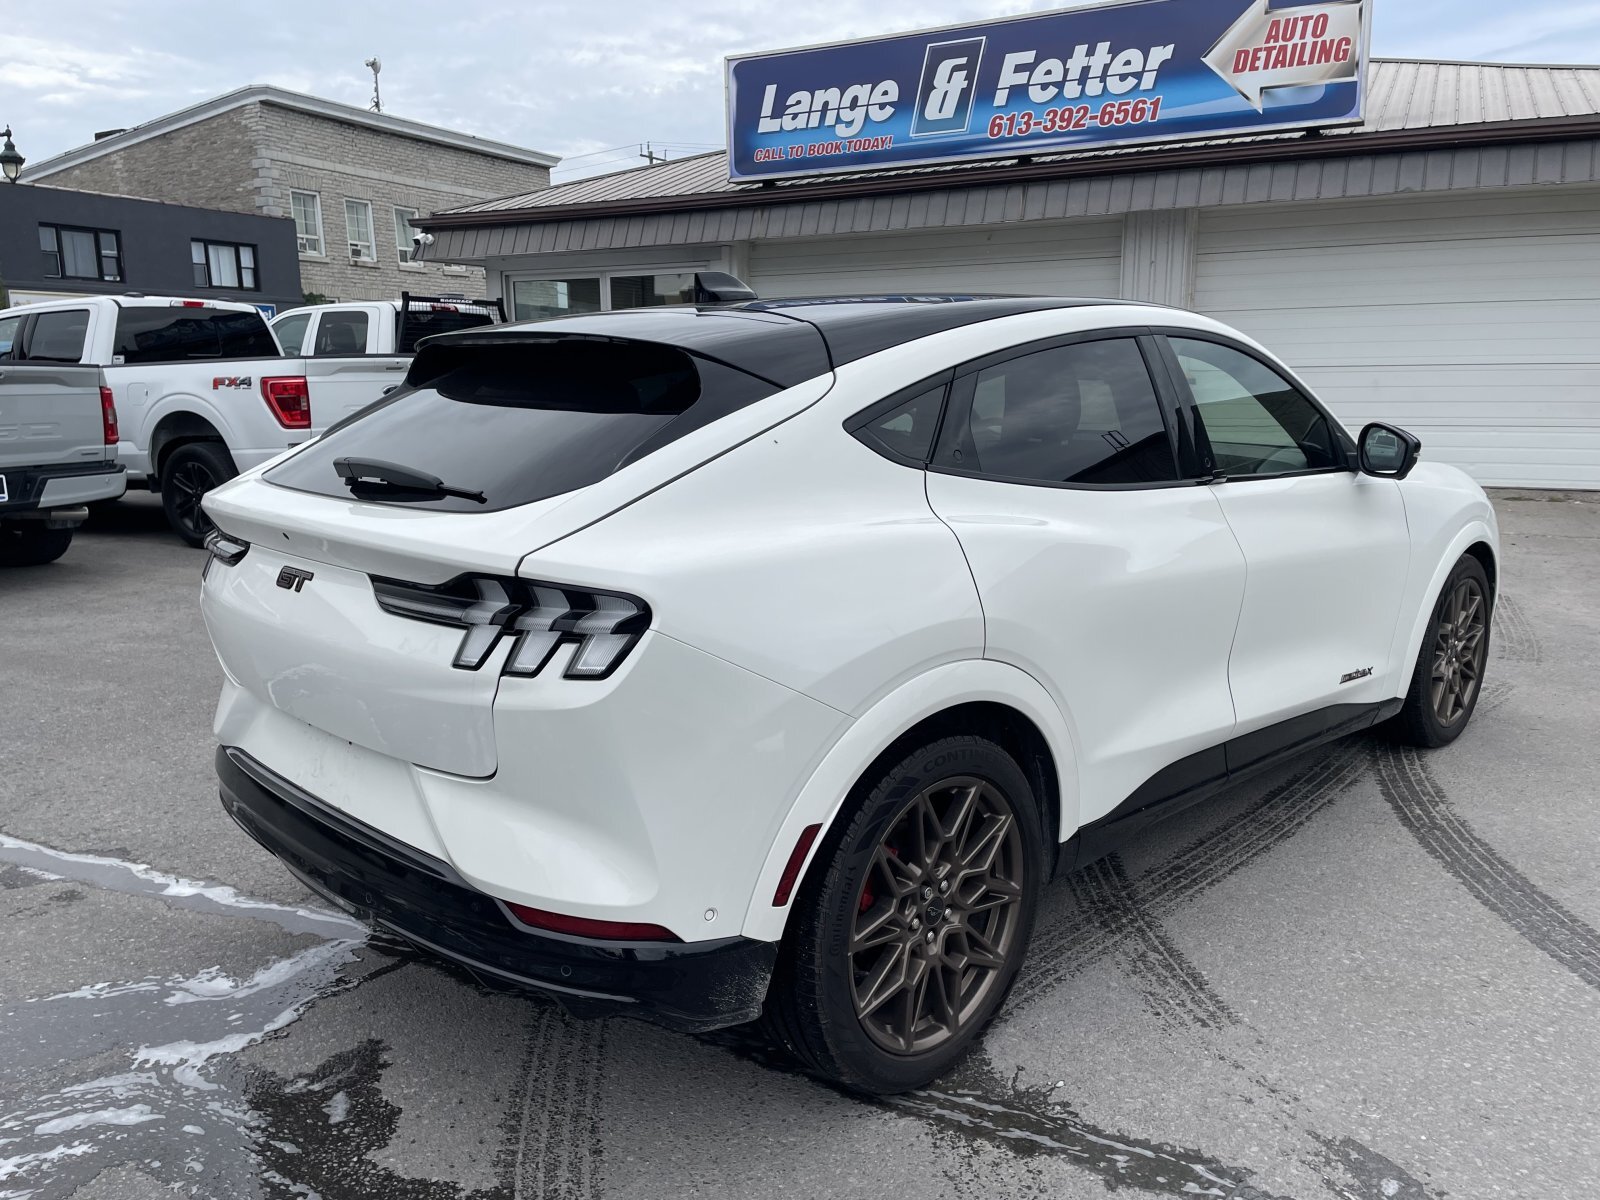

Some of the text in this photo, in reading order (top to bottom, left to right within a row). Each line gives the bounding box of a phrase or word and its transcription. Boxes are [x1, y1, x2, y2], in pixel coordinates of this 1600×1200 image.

[1264, 13, 1329, 45] AUTO
[1232, 36, 1352, 75] DETAILING
[757, 41, 1175, 138] Lange & Fetter
[987, 95, 1163, 139] 613-392-6561
[754, 134, 894, 163] CALL TO BOOK TODAY!
[212, 376, 252, 390] FX4
[276, 565, 315, 593] GT
